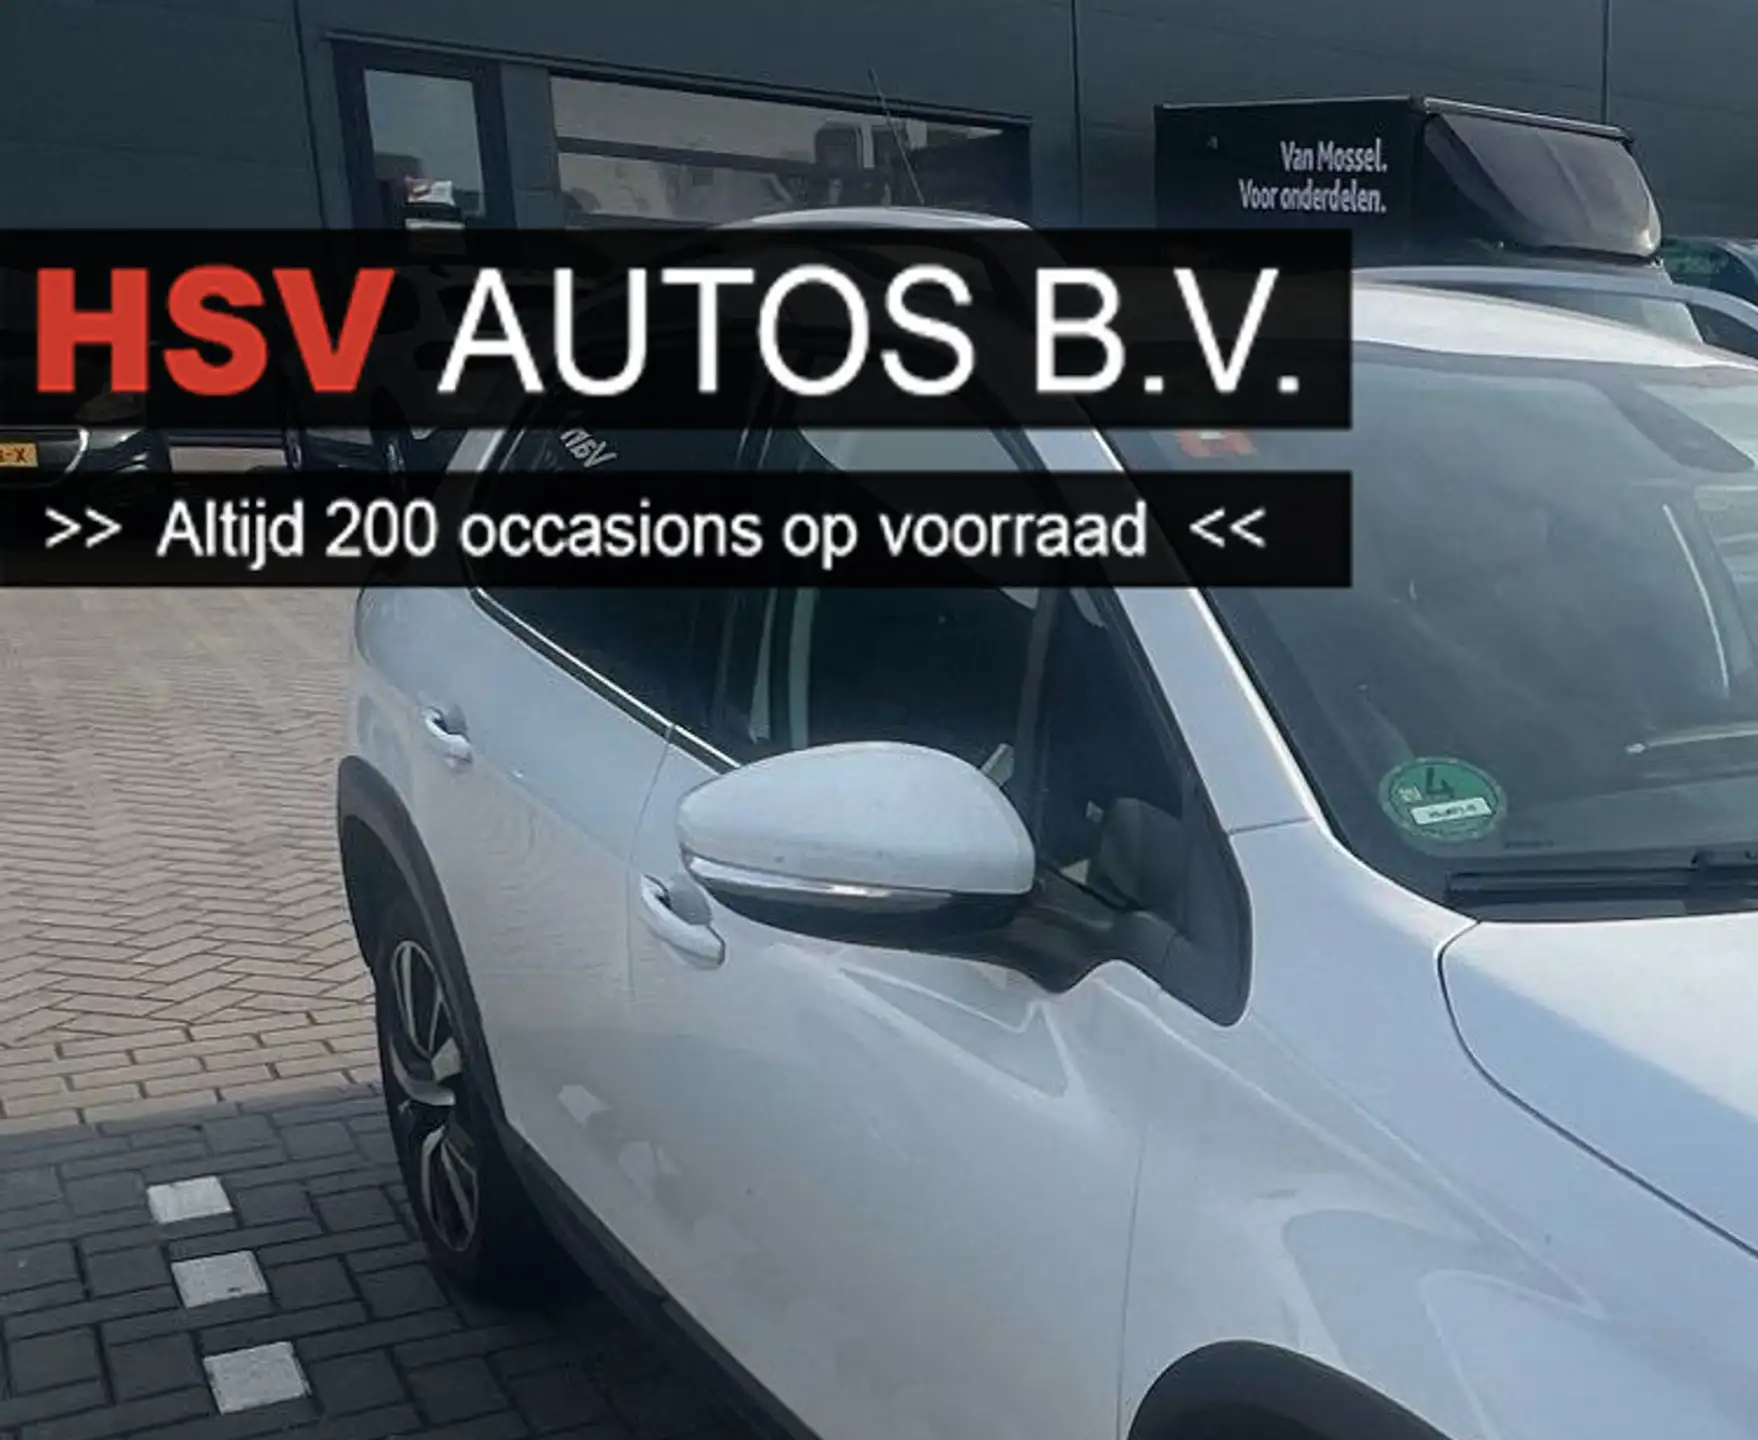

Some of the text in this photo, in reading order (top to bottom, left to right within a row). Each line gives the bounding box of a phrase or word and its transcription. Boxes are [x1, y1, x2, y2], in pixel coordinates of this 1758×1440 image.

[1279, 137, 1389, 173] Van Mossel.
[1238, 178, 1388, 213] Voor onderdelen.
